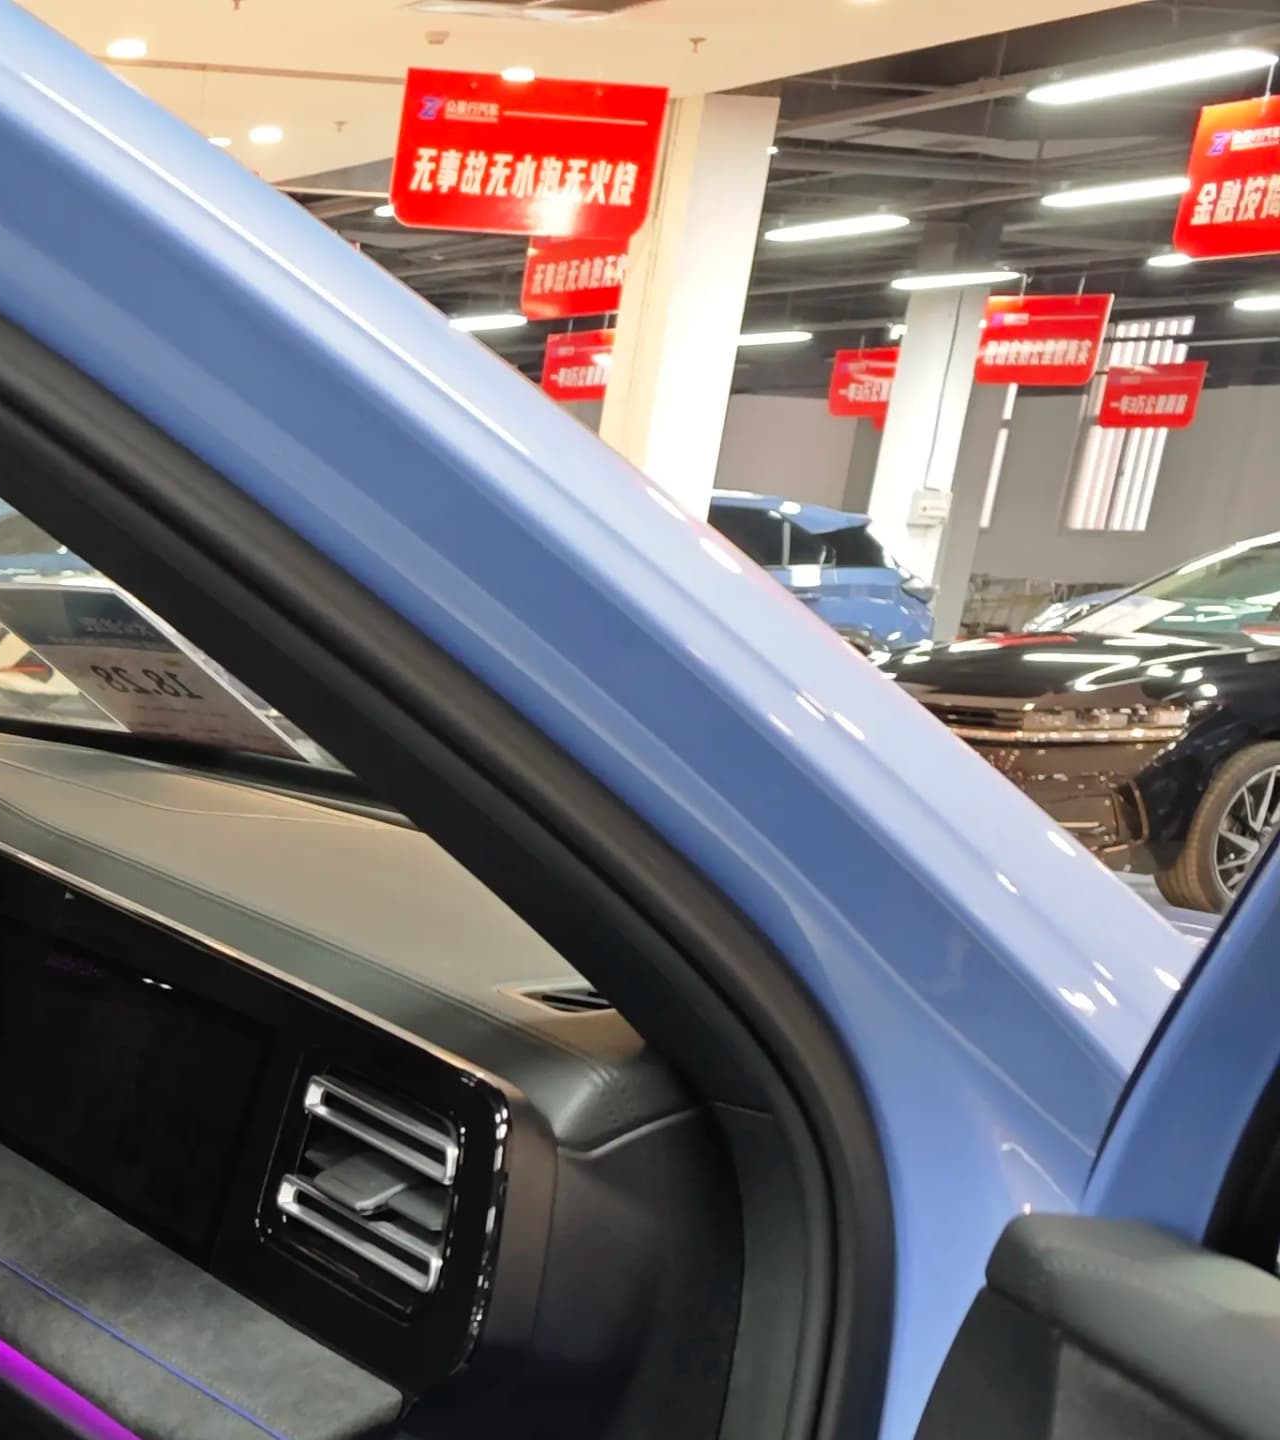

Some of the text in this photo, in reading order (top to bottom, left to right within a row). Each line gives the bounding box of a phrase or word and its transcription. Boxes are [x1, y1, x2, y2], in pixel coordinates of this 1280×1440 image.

[409, 148, 638, 206] 无事故无水泡无火烧
